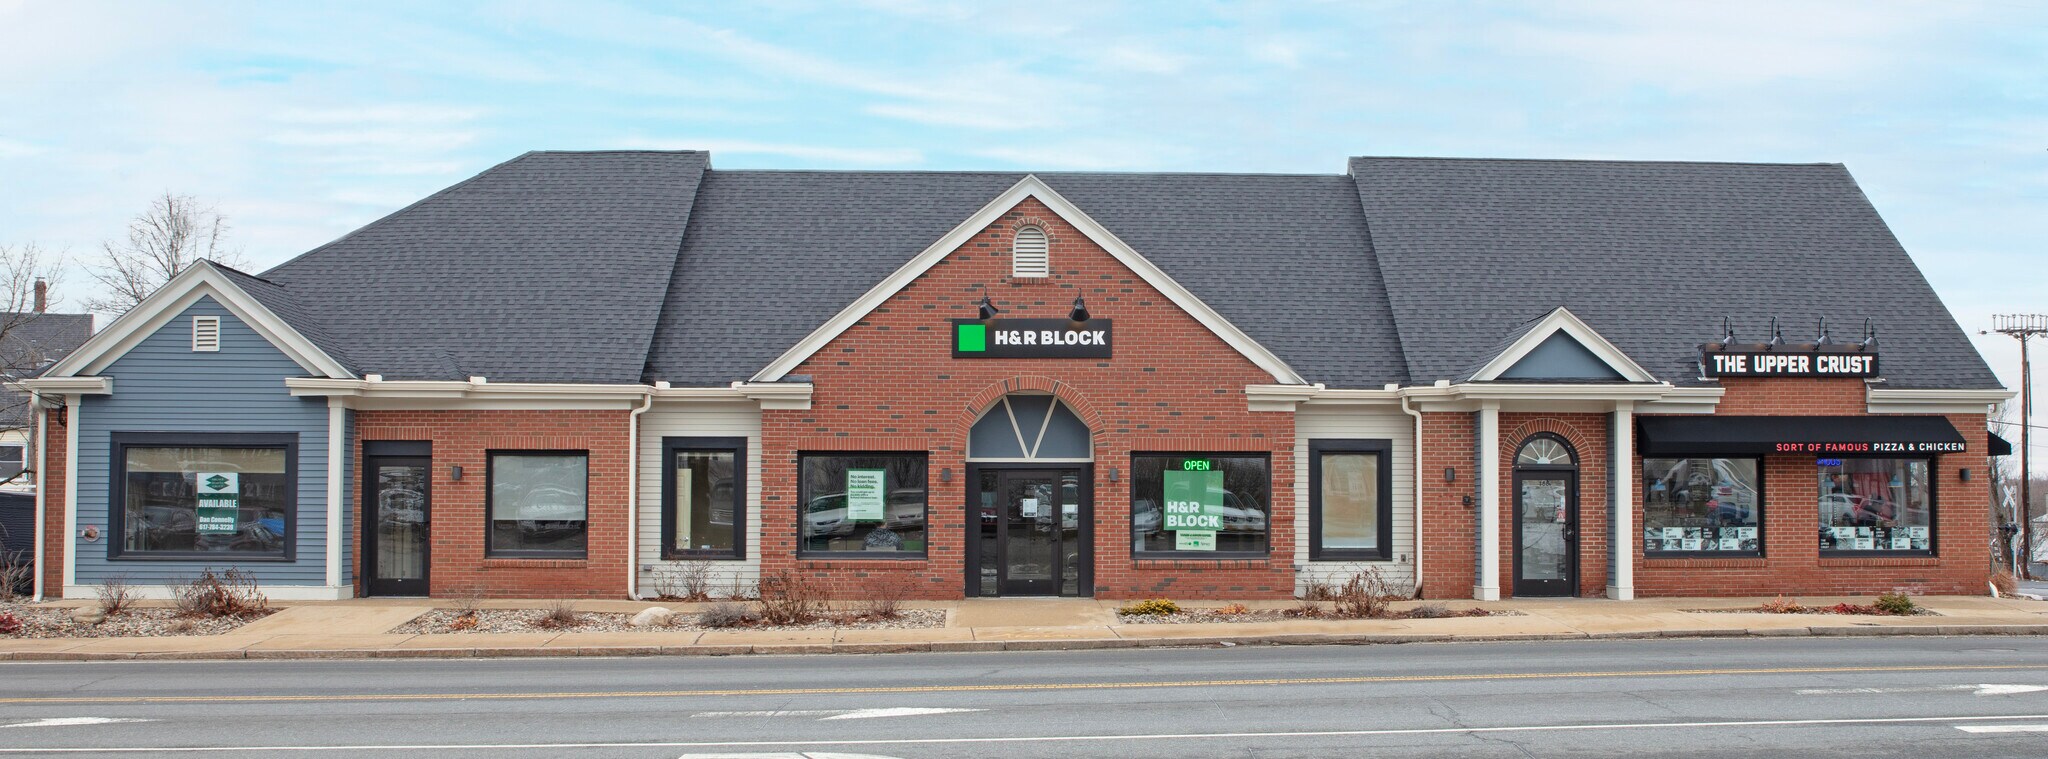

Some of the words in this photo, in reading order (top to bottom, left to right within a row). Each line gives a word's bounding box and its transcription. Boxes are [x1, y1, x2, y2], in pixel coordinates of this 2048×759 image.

[994, 330, 1037, 346] H&R
[1041, 330, 1106, 346] BLOCK
[1713, 355, 1747, 373] THE
[1753, 355, 1810, 373] UPPER
[1816, 356, 1873, 373] CRUST
[1776, 443, 1804, 451] SORT
[1807, 443, 1821, 451] OF
[1825, 443, 1869, 451] FAMOUS
[1873, 443, 1905, 451] PIZZA
[1908, 443, 1915, 451] &
[1919, 443, 1965, 451] CHICKEN
[1184, 460, 1210, 470] OPEN
[1167, 501, 1200, 513] H&R
[1167, 515, 1219, 527] BLOCK
